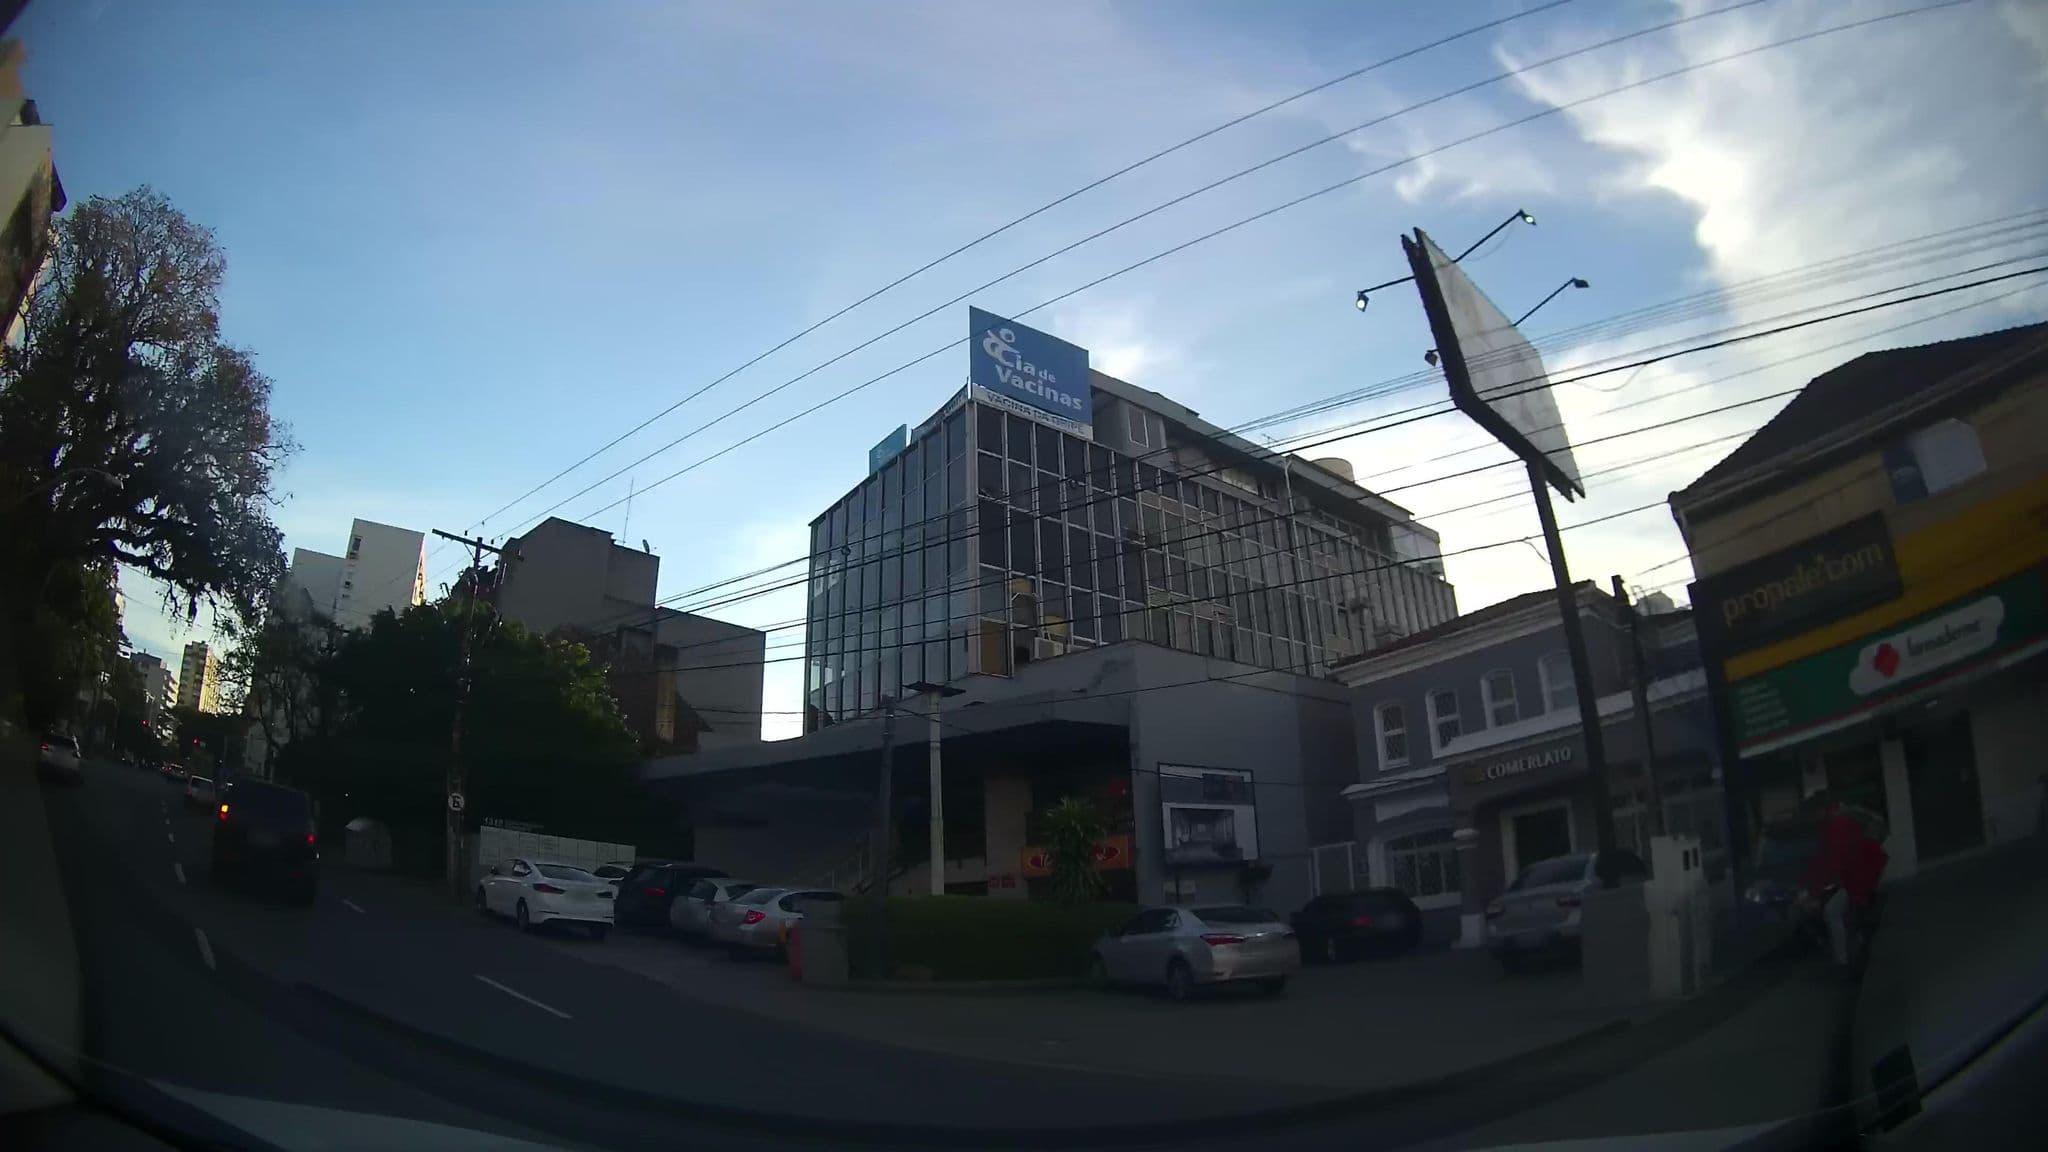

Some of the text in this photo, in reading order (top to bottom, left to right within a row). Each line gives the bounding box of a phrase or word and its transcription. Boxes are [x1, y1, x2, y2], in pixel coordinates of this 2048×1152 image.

[995, 364, 1084, 411] Vacinas
[1038, 368, 1057, 384] de
[1487, 746, 1573, 780] COMERLATO
